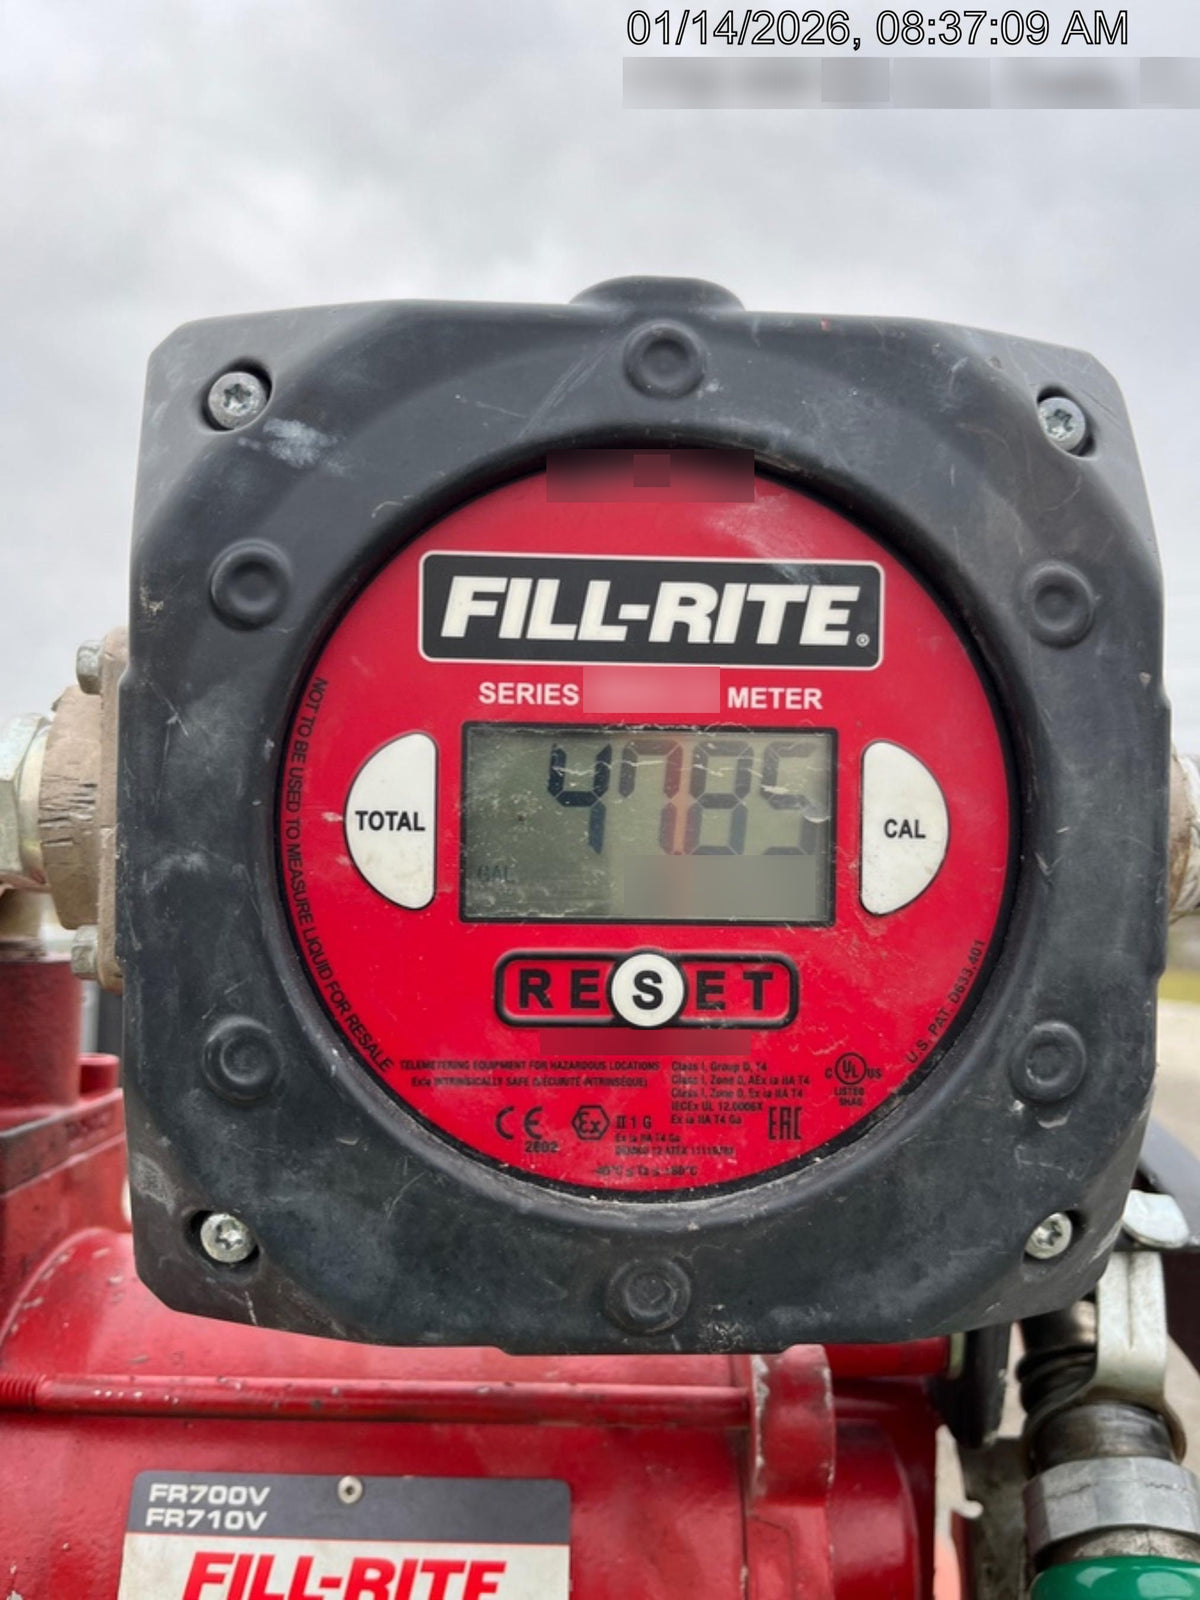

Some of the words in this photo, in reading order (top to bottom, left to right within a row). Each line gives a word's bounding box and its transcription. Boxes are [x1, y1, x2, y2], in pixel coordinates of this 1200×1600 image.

[440, 576, 861, 646] FILL-RITE
[305, 676, 329, 712] NOT
[478, 681, 580, 706] SERIES
[726, 686, 824, 710] METER
[297, 715, 316, 736] TO
[291, 740, 309, 763] BE
[286, 767, 305, 813] USED
[286, 818, 301, 840] TO
[355, 810, 426, 832] TOTAL
[883, 818, 927, 839] CAL
[286, 843, 314, 926] MEASURE
[303, 927, 334, 982] LIQUID
[326, 981, 353, 1016] FOR
[518, 967, 774, 1011] RESET
[344, 1013, 395, 1074] RESALE
[529, 1060, 548, 1071] FOR
[609, 1060, 660, 1071] LOCATIONS
[148, 1483, 271, 1506] FR700V
[145, 1508, 268, 1531] FR710V
